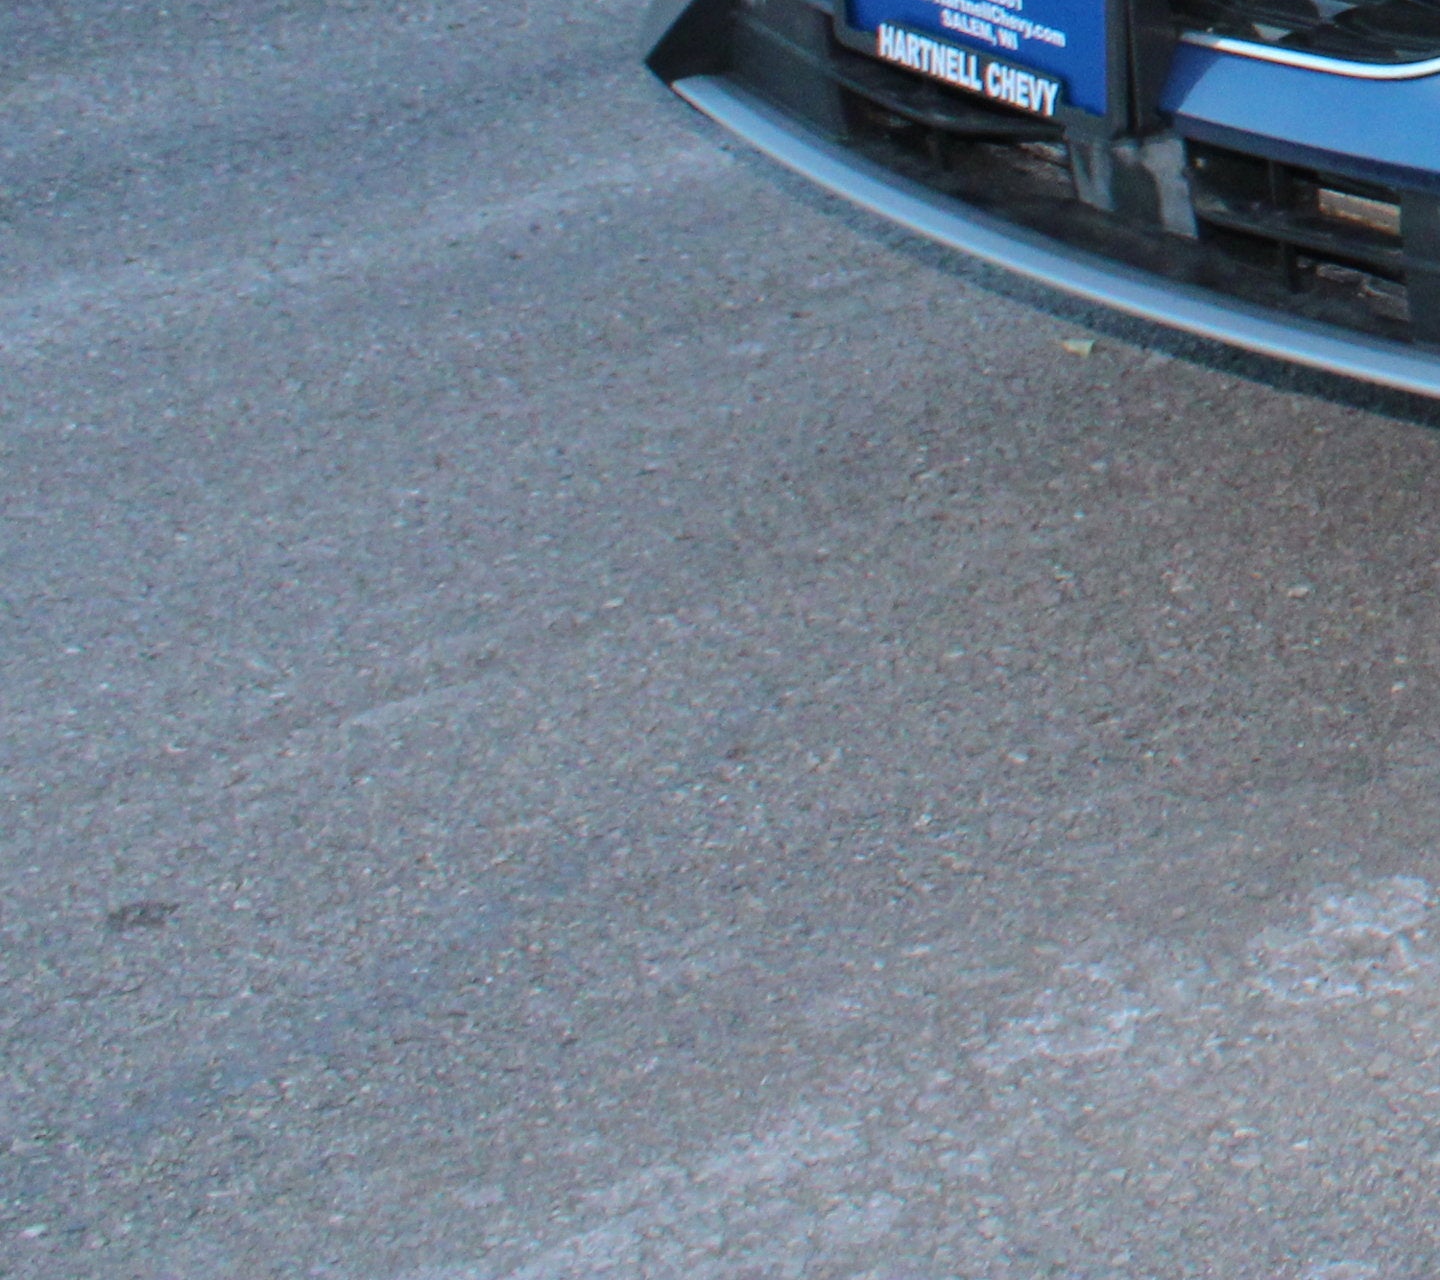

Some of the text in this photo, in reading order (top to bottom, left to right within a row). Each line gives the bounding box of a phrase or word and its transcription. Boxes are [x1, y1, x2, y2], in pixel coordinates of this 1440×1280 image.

[941, 8, 1018, 51] SALEM, WI
[877, 22, 1059, 117] HARTNELL CHEVY
